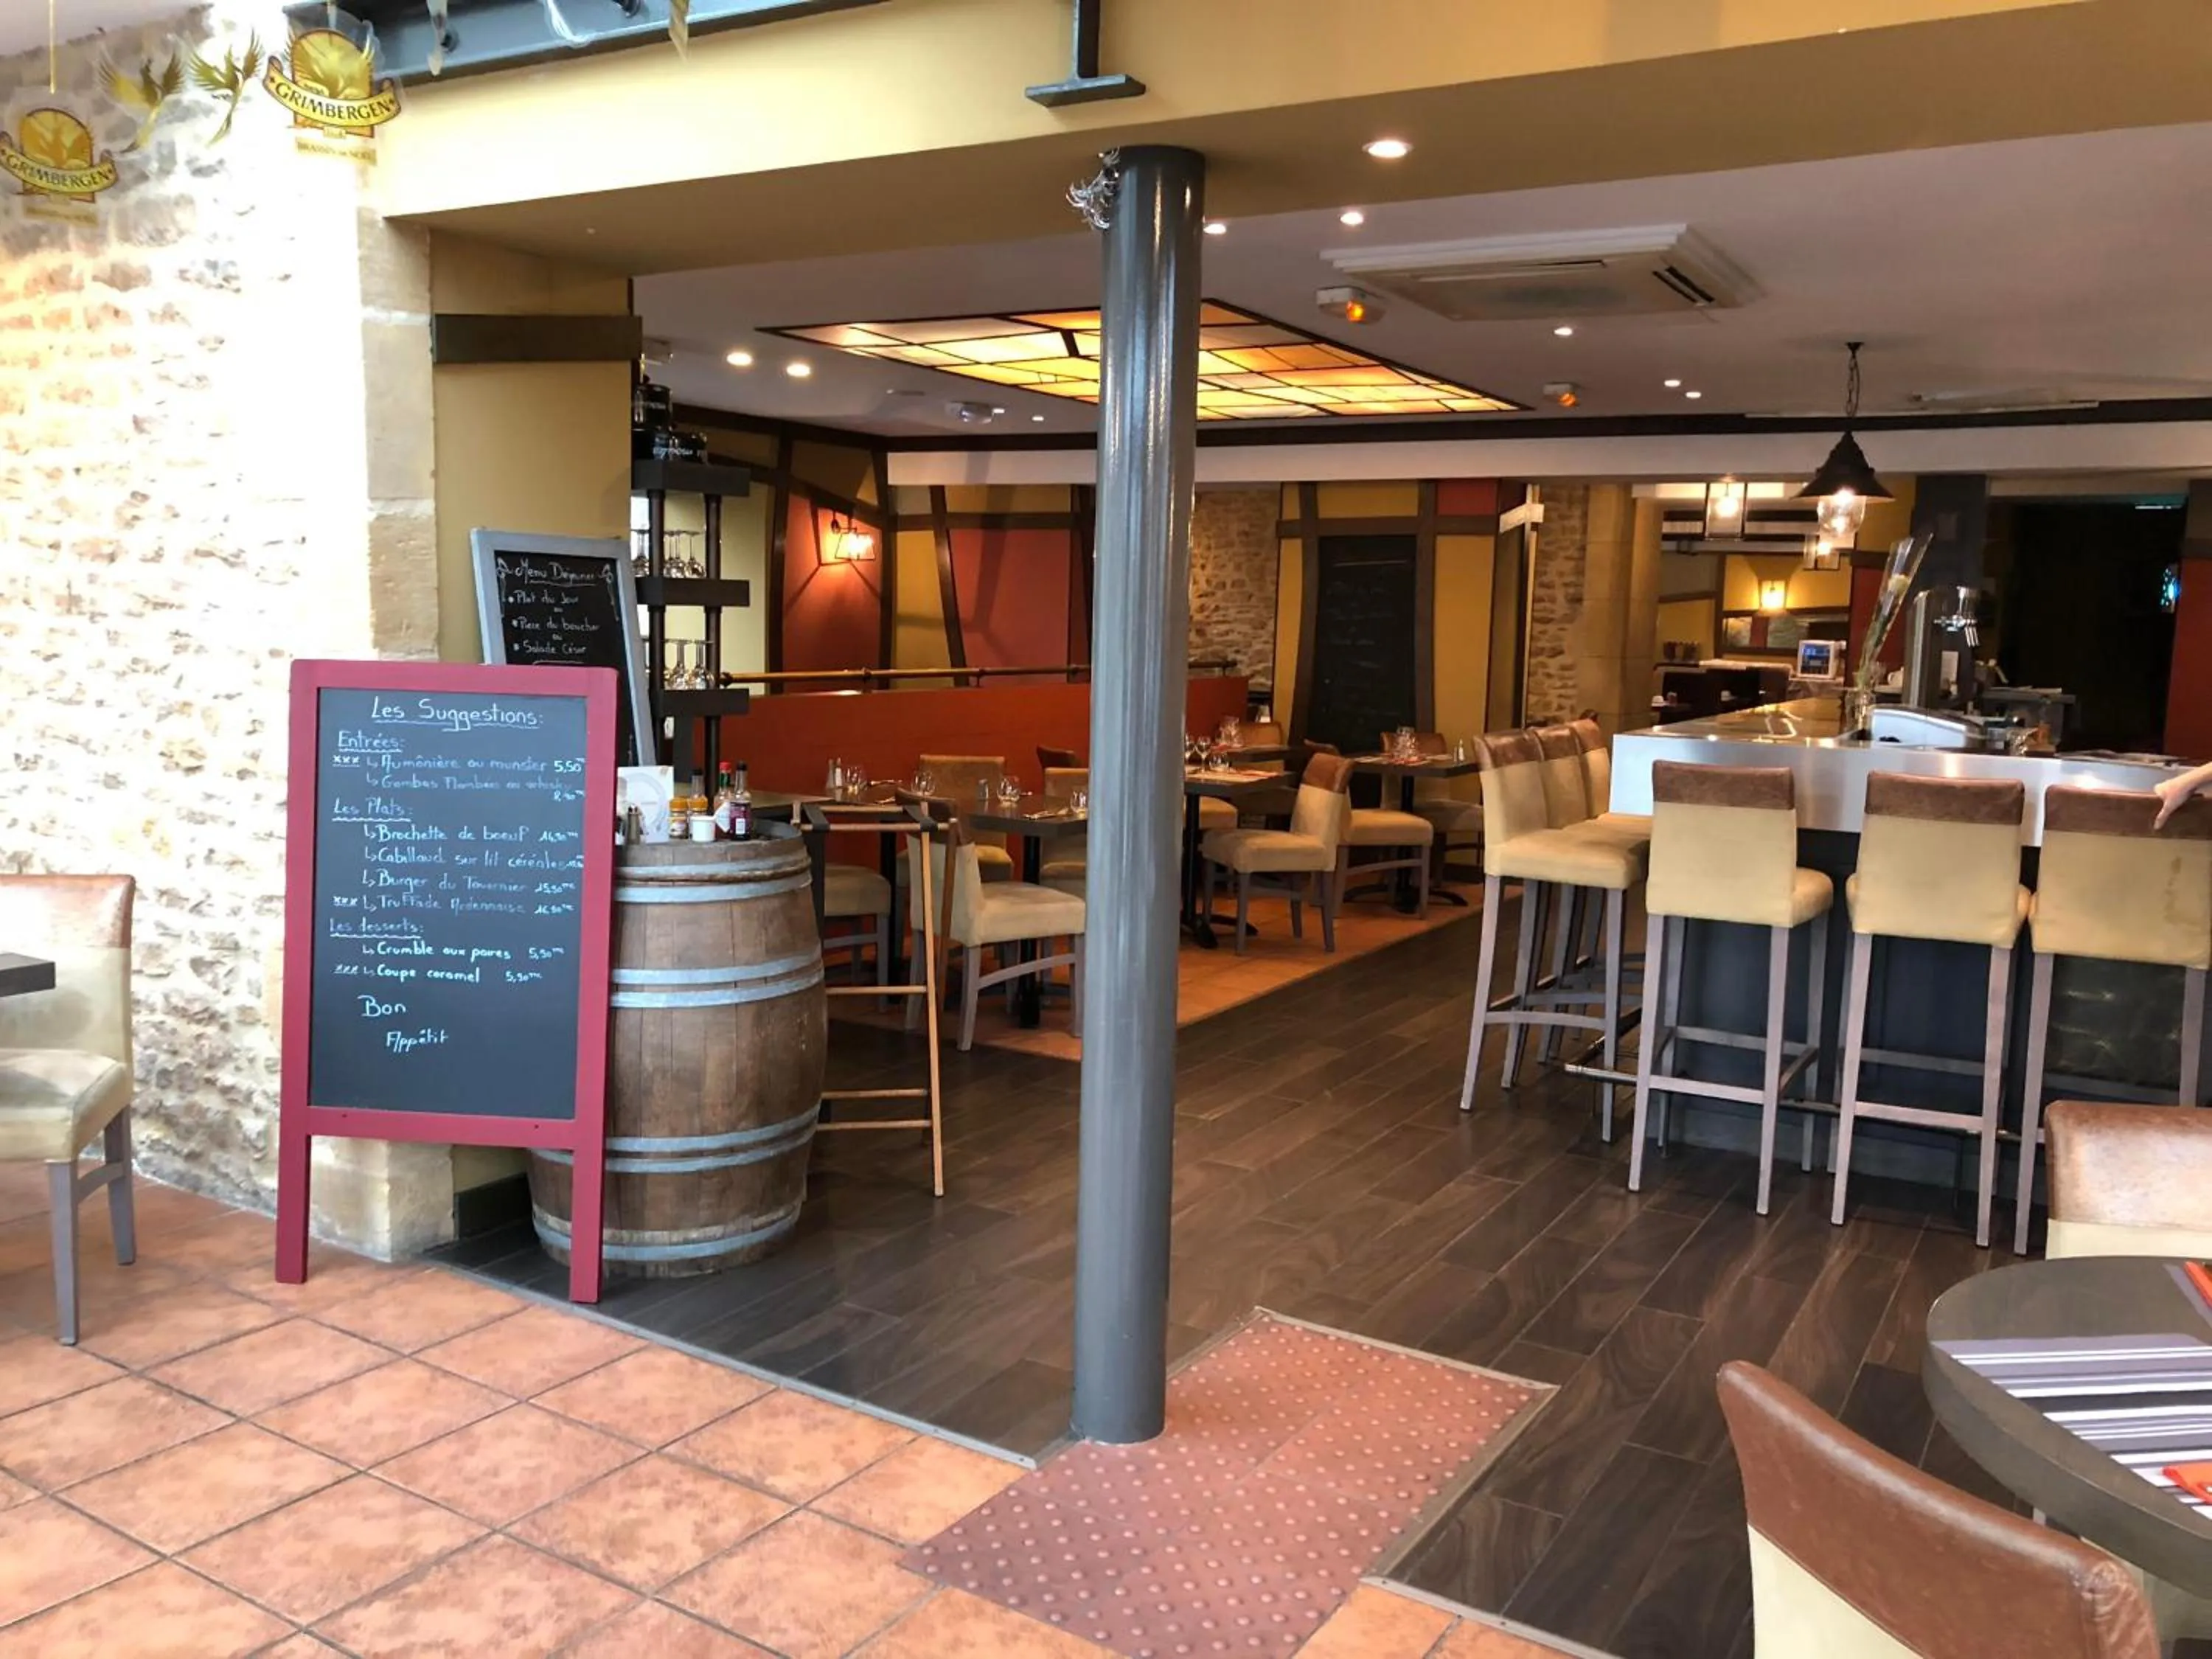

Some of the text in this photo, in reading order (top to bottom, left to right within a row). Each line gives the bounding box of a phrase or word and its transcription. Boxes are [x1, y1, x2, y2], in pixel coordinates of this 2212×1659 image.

[275, 82, 392, 120] GRIMBERGEN
[7, 154, 110, 187] GRIMBERGEN
[514, 590, 535, 603] Plat
[523, 641, 555, 653] Salade
[372, 696, 405, 719] Les
[382, 773, 438, 790] Gambas
[334, 797, 360, 814] Les
[378, 824, 448, 841] Brochette
[458, 826, 476, 840] de
[378, 847, 445, 865] Cabillaud
[455, 855, 477, 866] sur
[377, 869, 428, 894] Burger
[439, 872, 456, 891] du
[330, 917, 352, 932] Les
[377, 940, 434, 956] Crumble
[443, 947, 466, 956] aux
[377, 964, 417, 983] Coupe
[427, 967, 480, 983] caramel
[357, 995, 406, 1017] Bon
